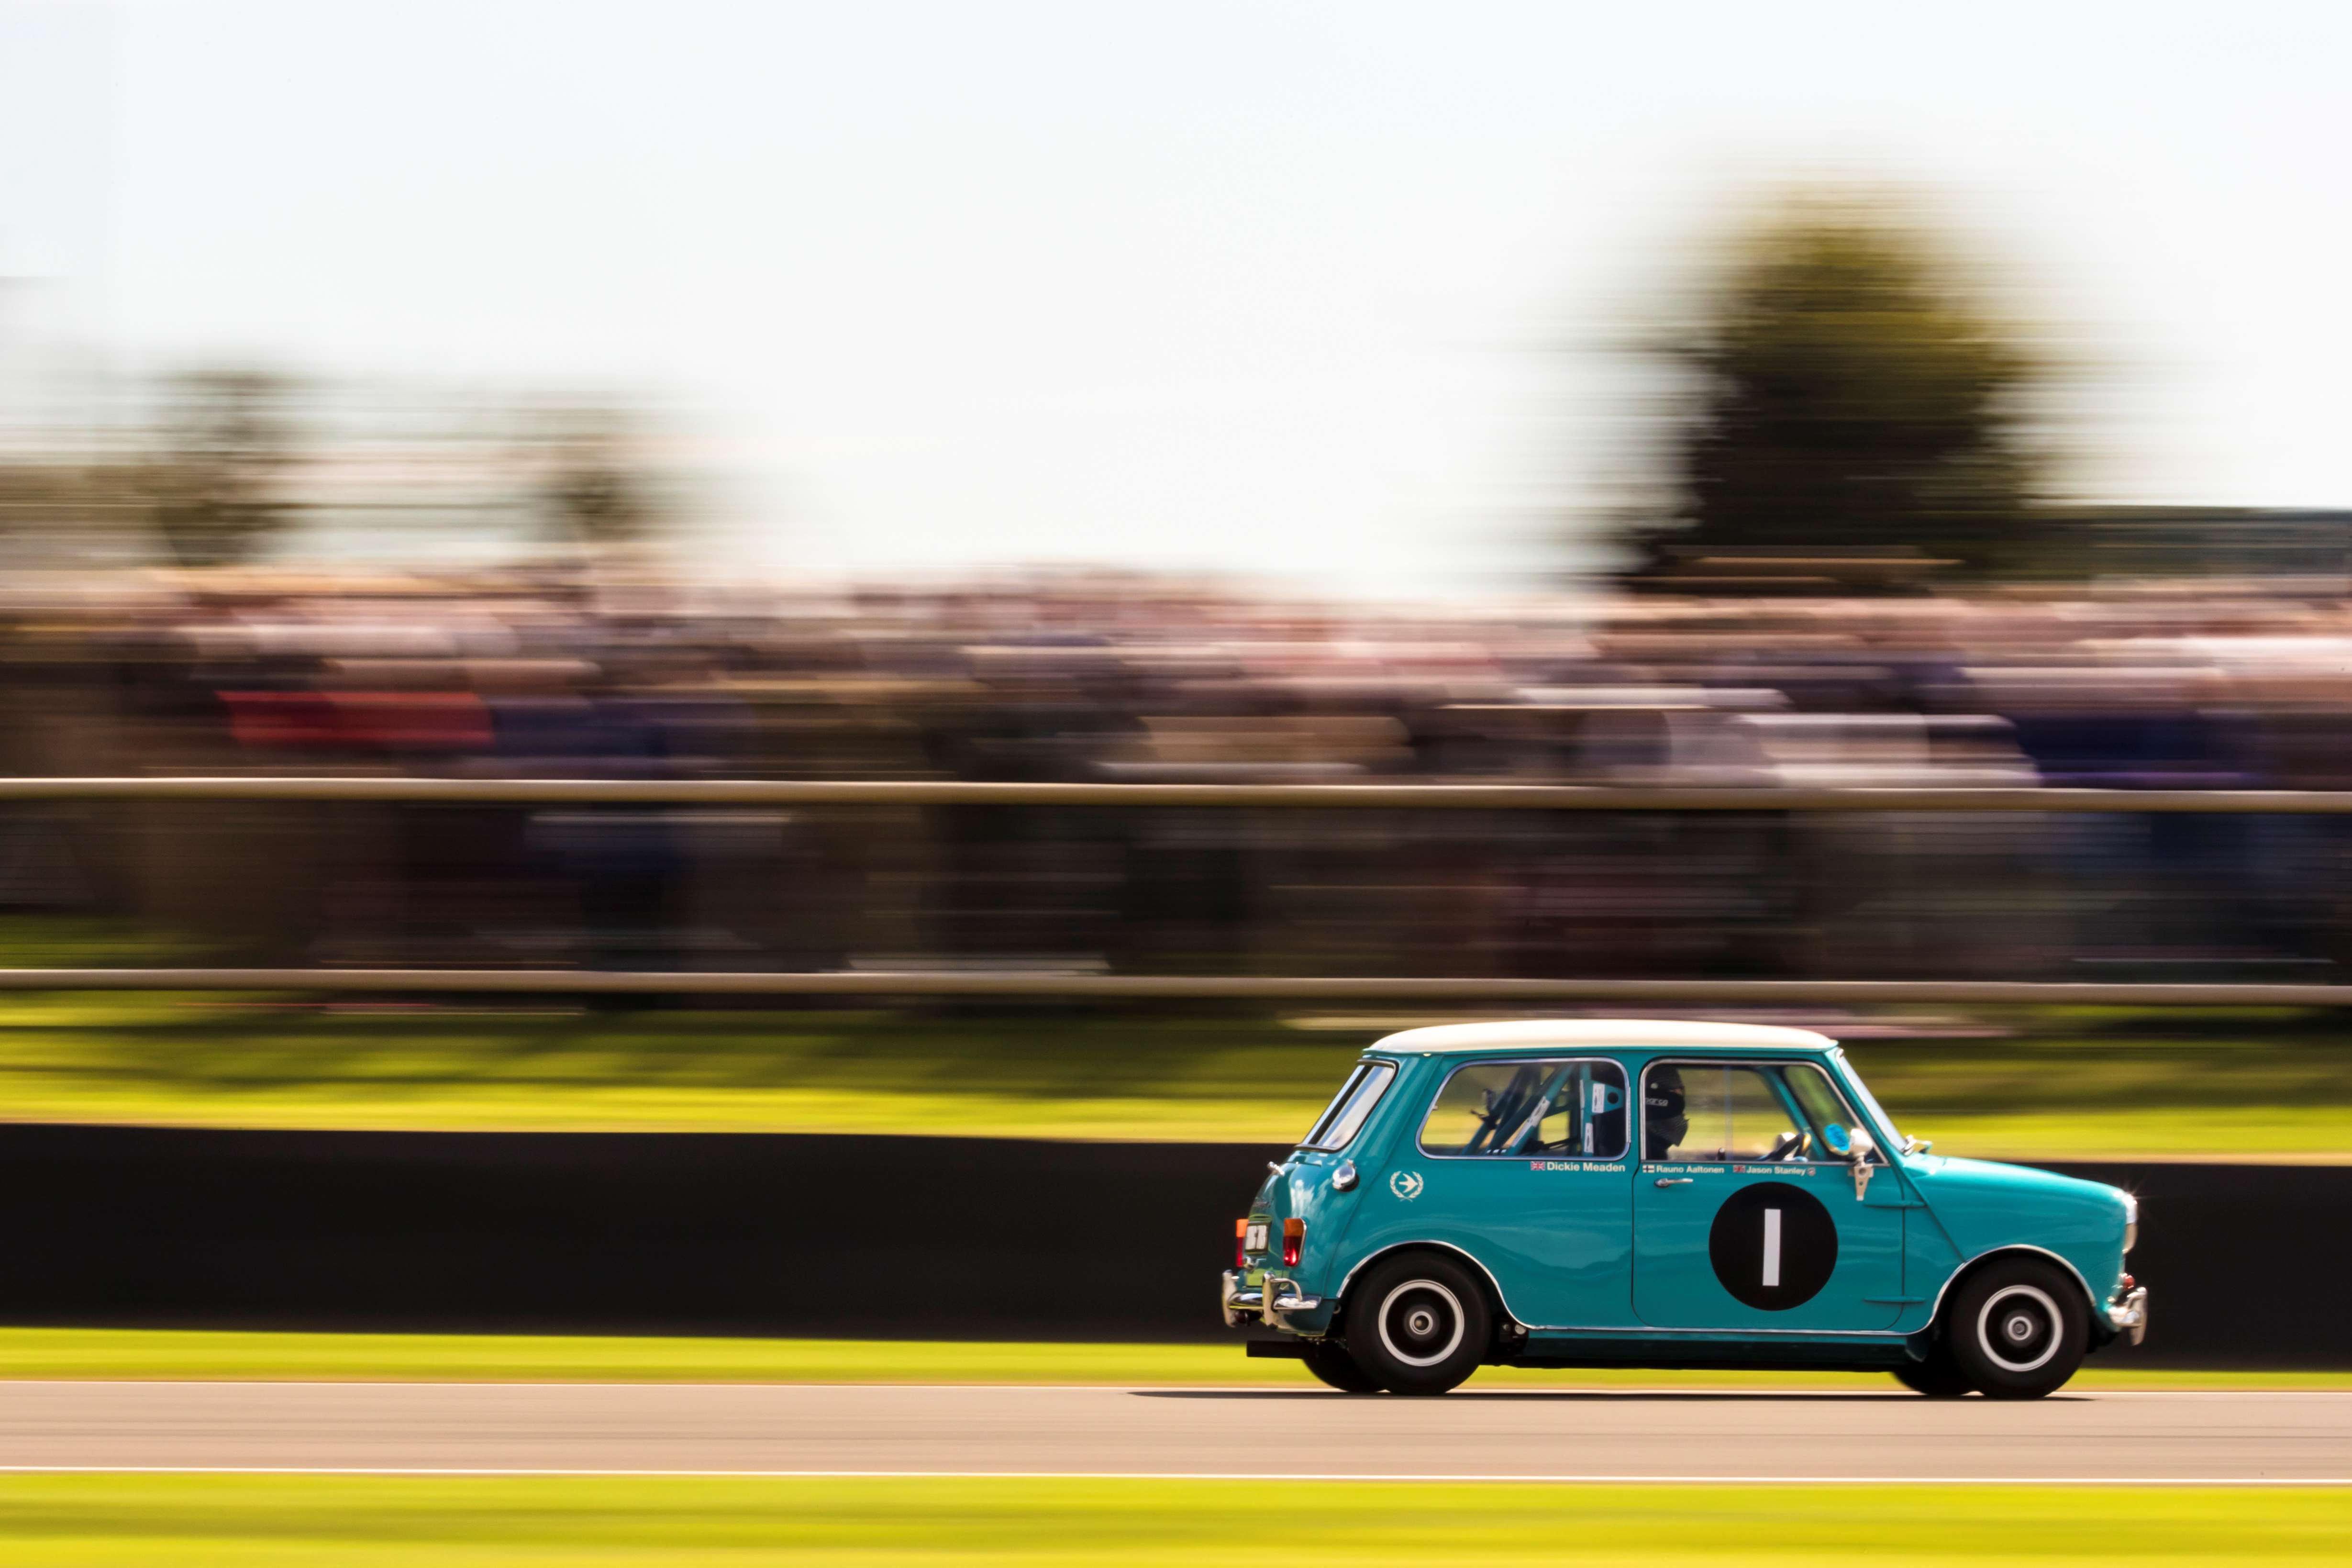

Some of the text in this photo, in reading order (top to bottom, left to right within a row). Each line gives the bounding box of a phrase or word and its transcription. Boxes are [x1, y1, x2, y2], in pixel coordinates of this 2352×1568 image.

[1547, 1162, 1625, 1171] Dickie Meaden
[1774, 1167, 1806, 1176] Stanley
[1763, 1209, 1781, 1286] 1
